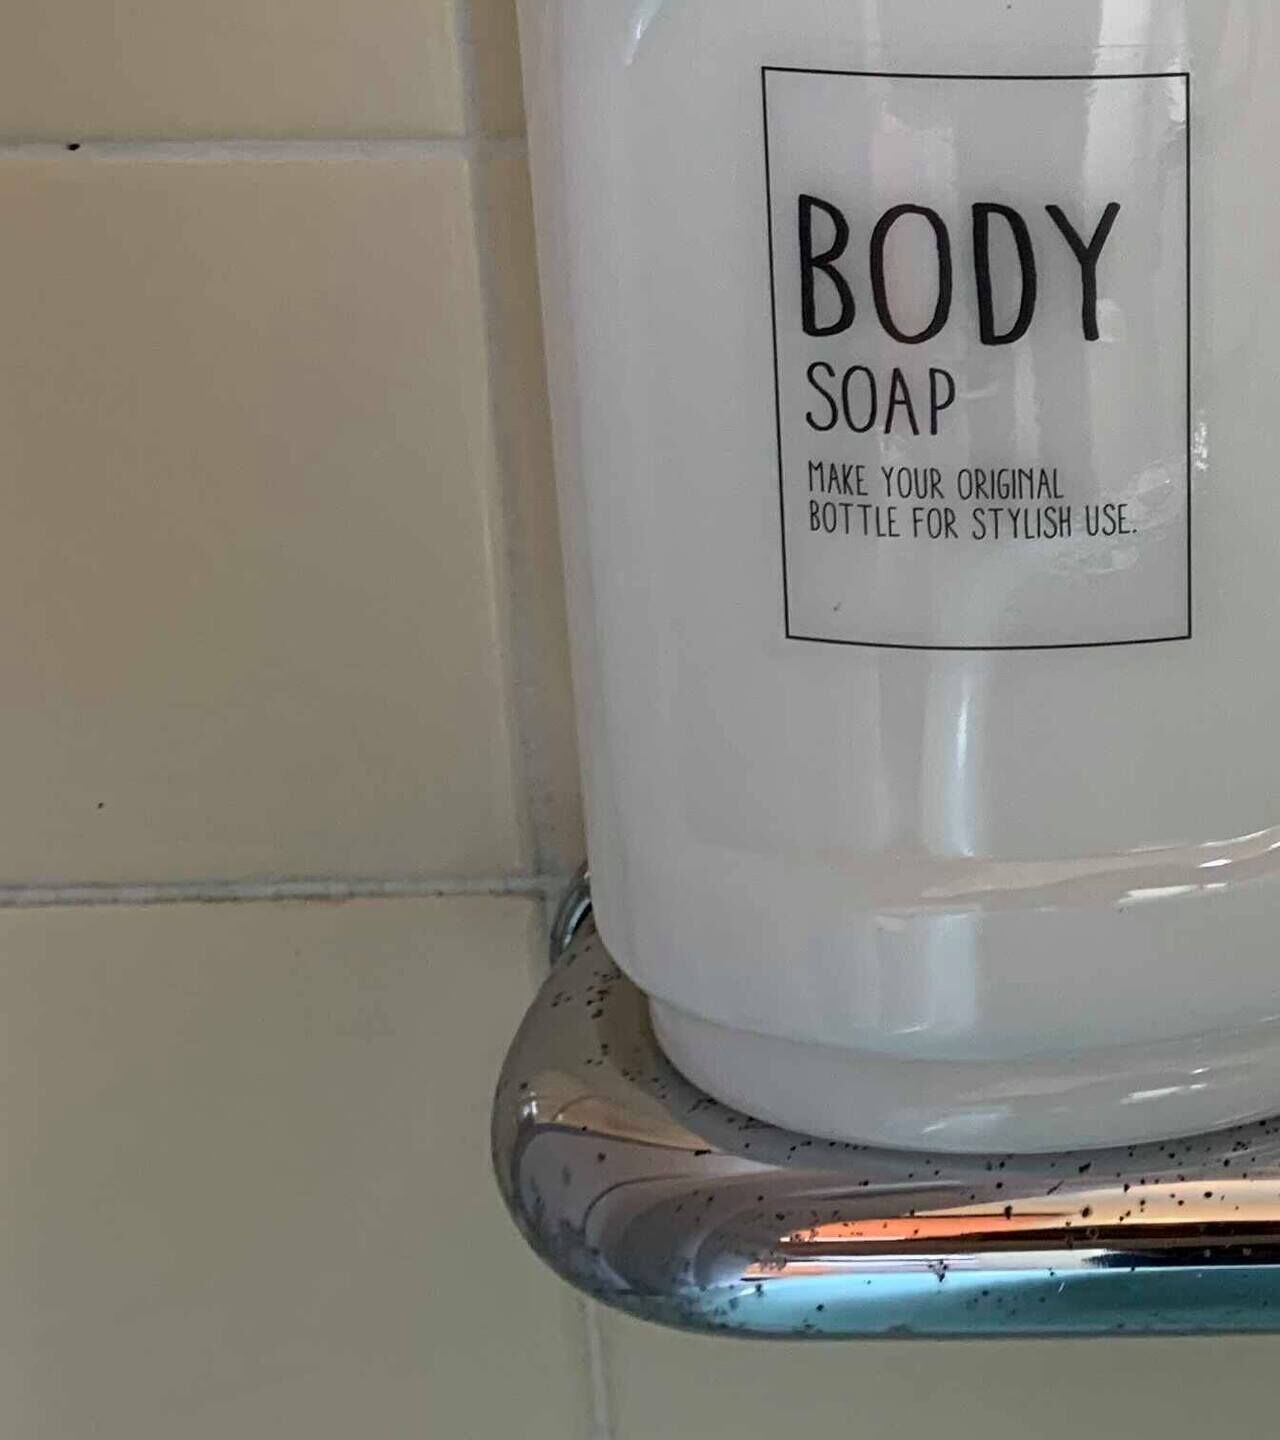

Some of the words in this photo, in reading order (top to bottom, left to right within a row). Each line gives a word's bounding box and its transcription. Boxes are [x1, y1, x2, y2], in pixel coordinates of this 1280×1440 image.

[798, 193, 1121, 345] BODY
[806, 361, 956, 436] SOAP
[808, 460, 866, 497] MAKE
[881, 466, 945, 500] YOUR
[957, 466, 1065, 501] ORIGINAL
[809, 501, 901, 538] BOTTLE
[913, 507, 959, 539] FOR
[973, 506, 1072, 540] STYLISH
[1086, 503, 1138, 536] USE.
